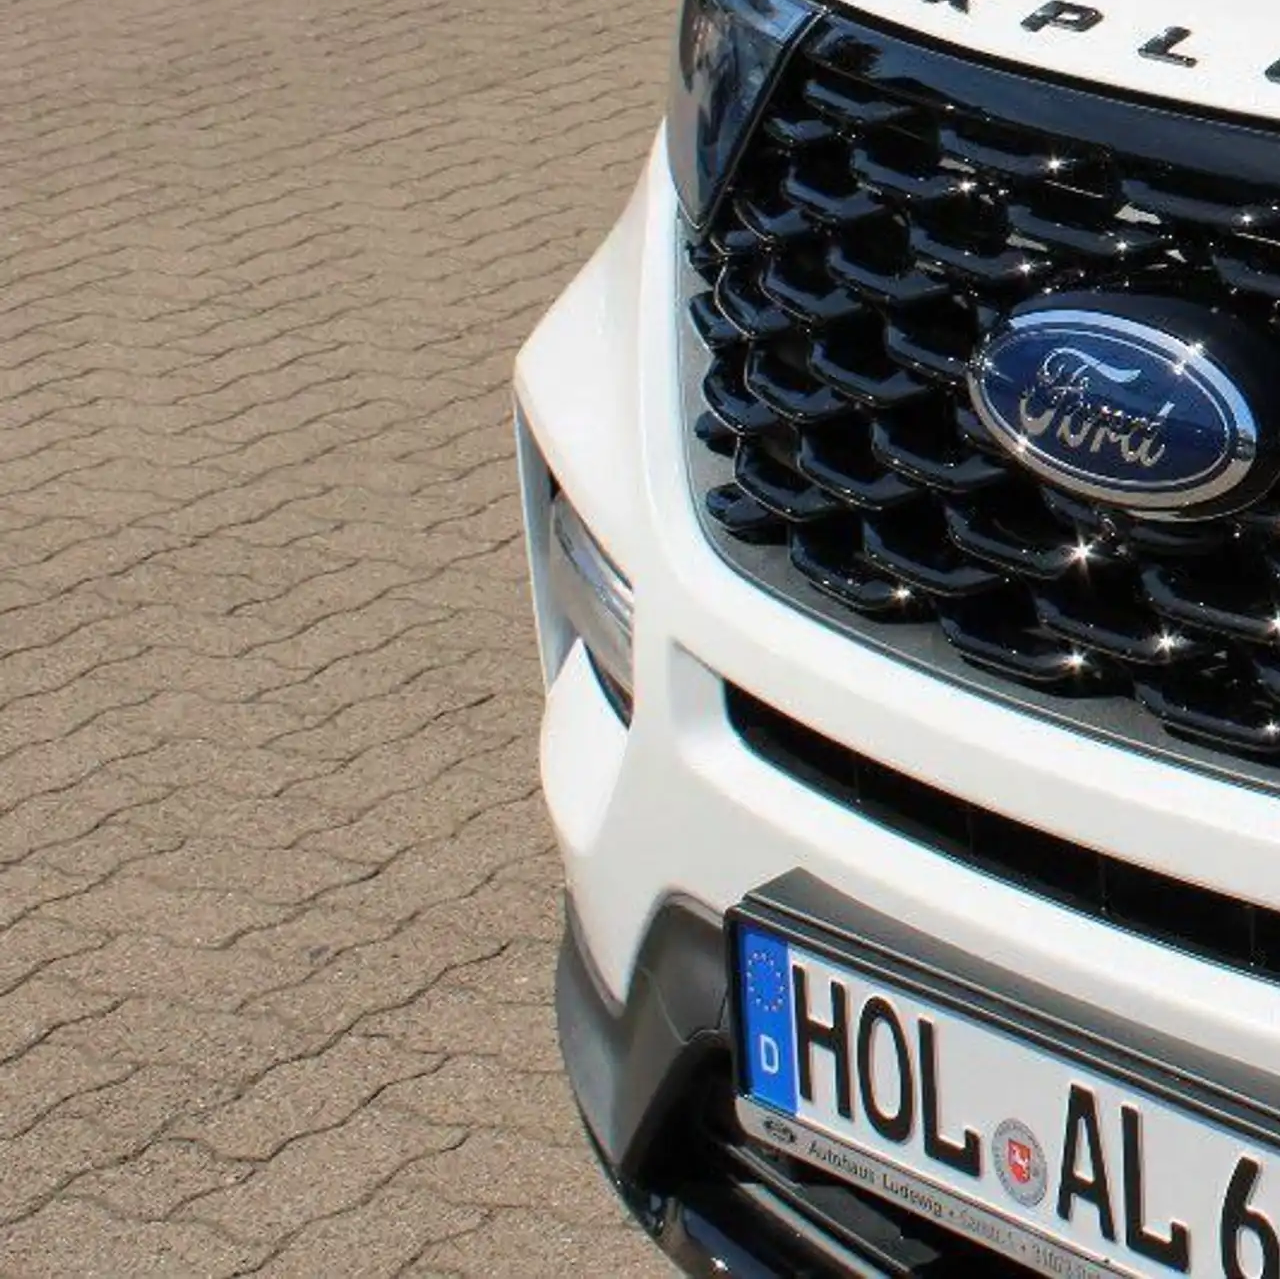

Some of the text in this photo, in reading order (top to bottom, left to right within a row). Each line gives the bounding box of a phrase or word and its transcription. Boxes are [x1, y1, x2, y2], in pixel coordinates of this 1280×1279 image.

[1019, 347, 1174, 468] Ford
[760, 1033, 780, 1075] D
[791, 963, 981, 1180] HOL
[1056, 1082, 1190, 1274] AL
[808, 1139, 943, 1219] Autohaus Ludewig
